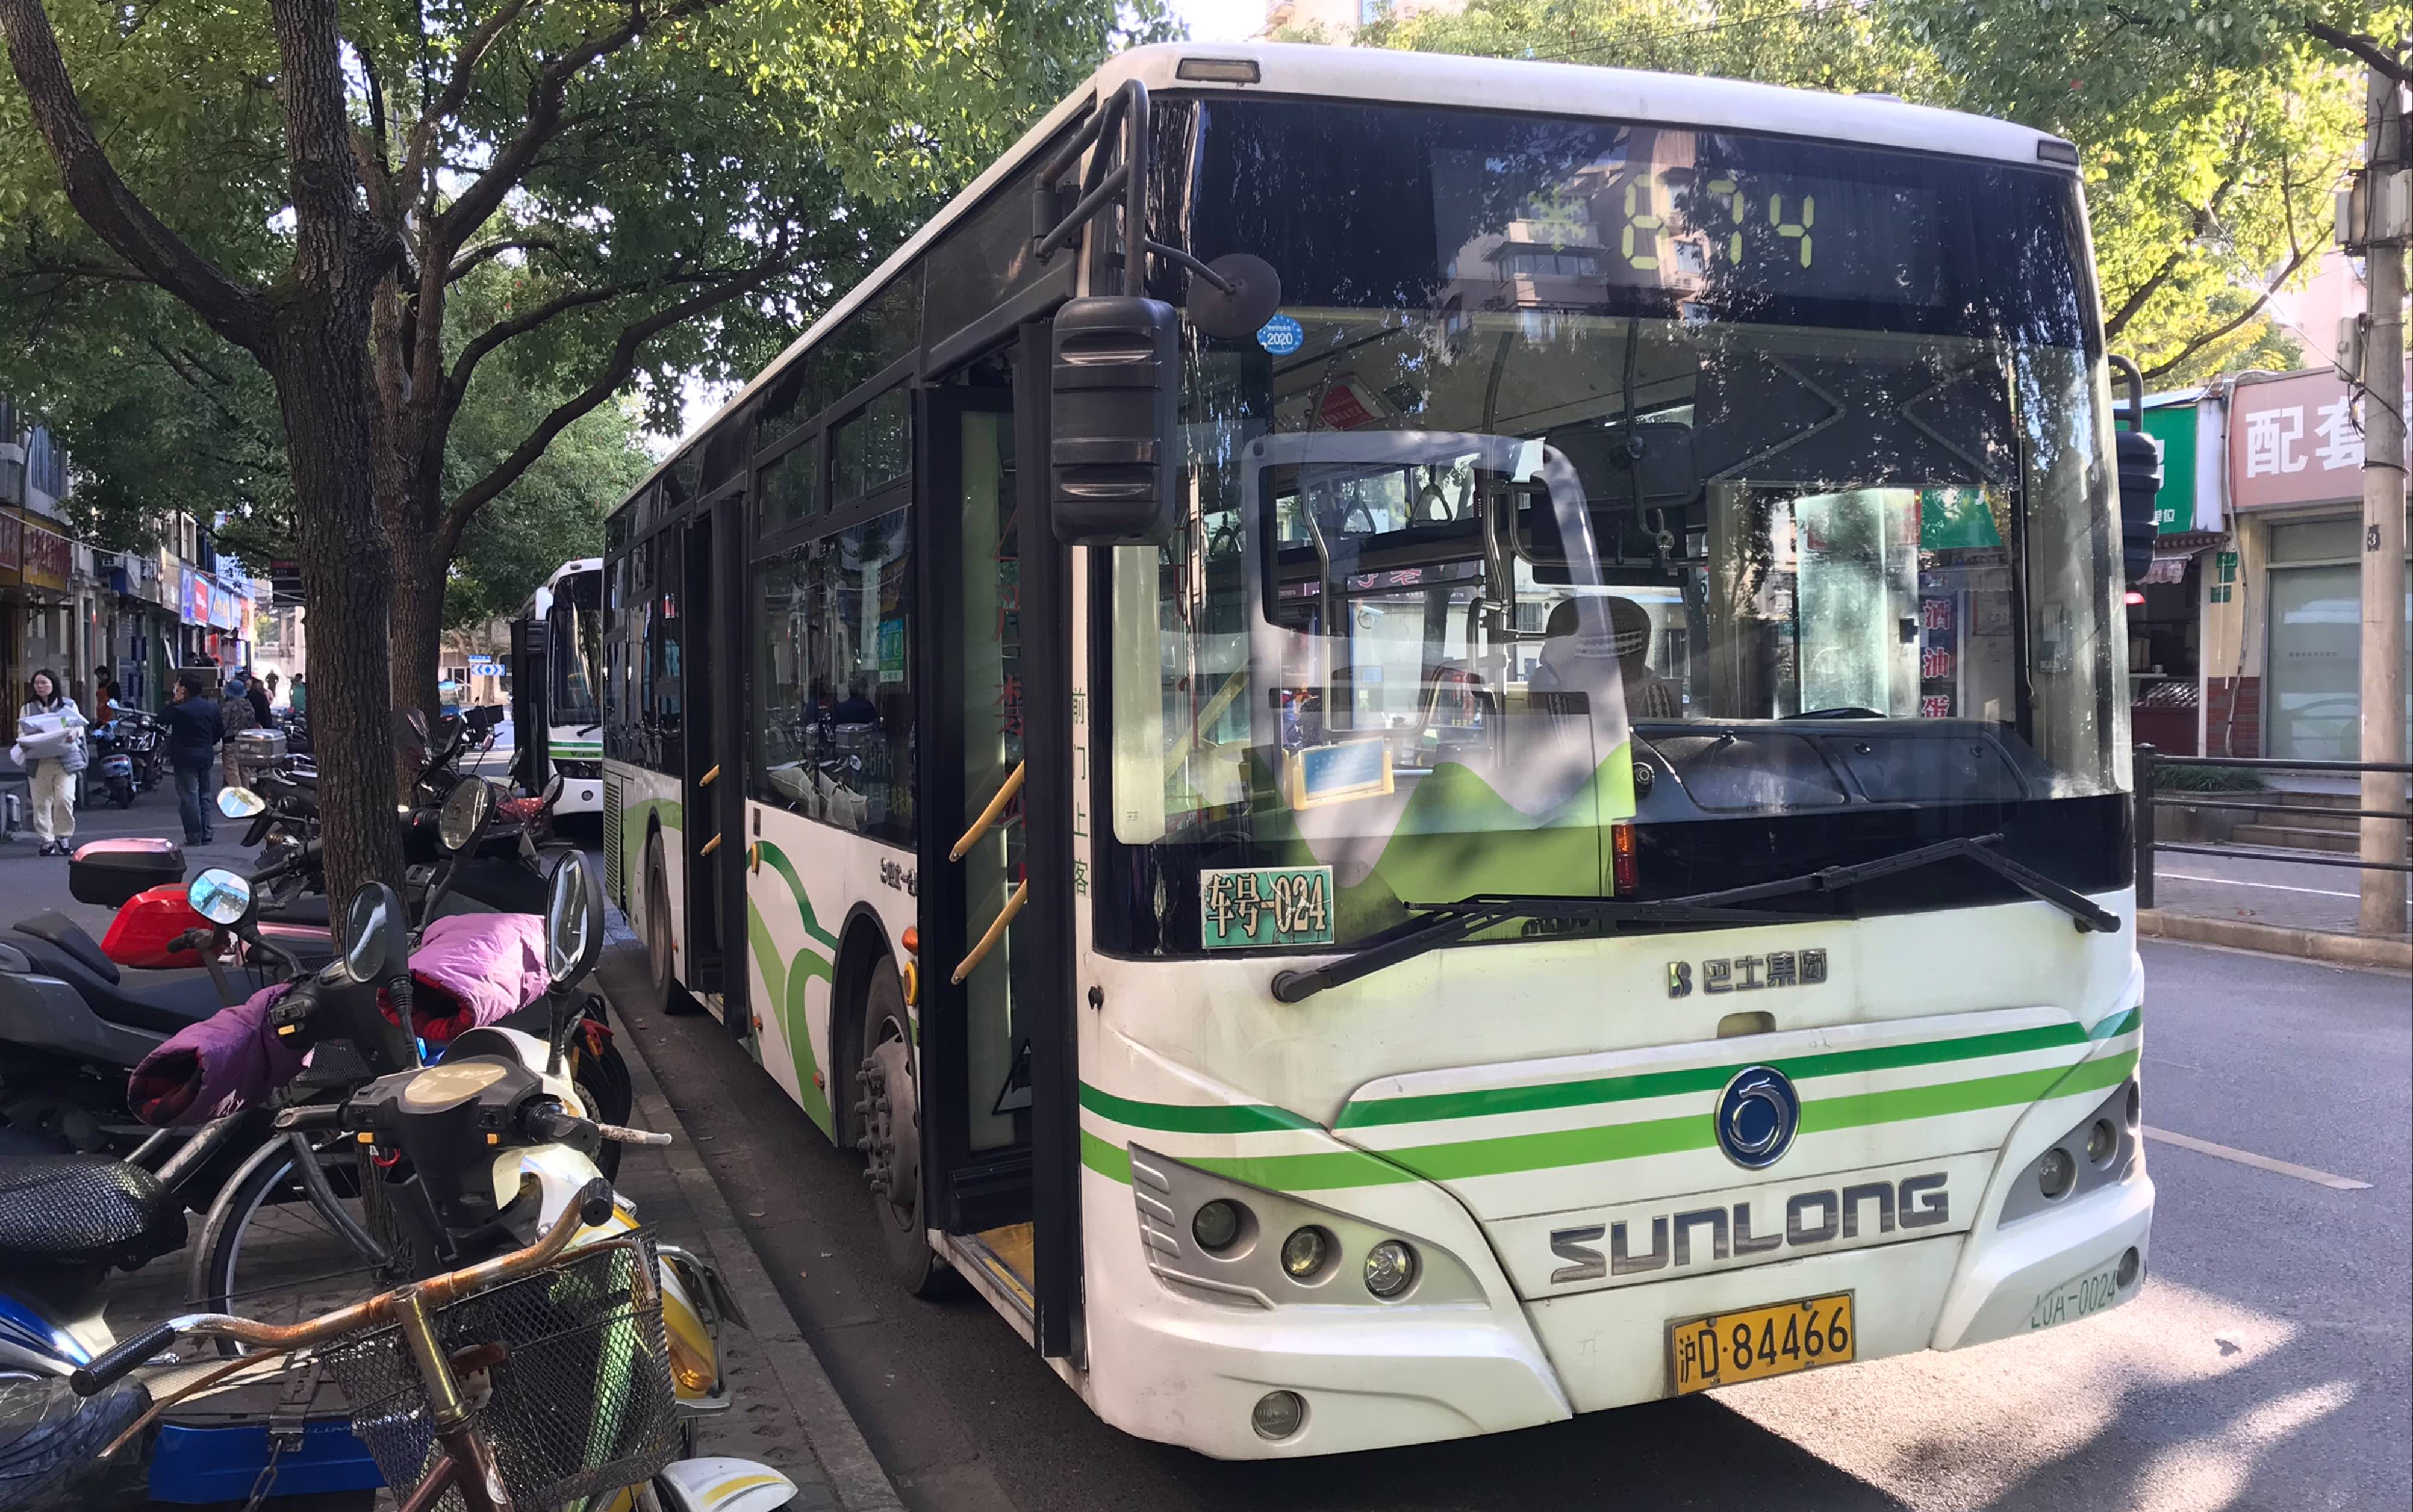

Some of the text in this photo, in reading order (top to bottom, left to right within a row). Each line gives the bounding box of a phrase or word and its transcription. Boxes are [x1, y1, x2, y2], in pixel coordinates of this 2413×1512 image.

[1622, 173, 1814, 269] 874
[1267, 332, 1293, 345] 2020
[2368, 533, 2377, 546] 3
[1072, 687, 1089, 897] 前门上客
[1206, 872, 1327, 938] 车号-024
[1702, 947, 1828, 995] 巴士集团
[1550, 1171, 1949, 1285] SUNLONG
